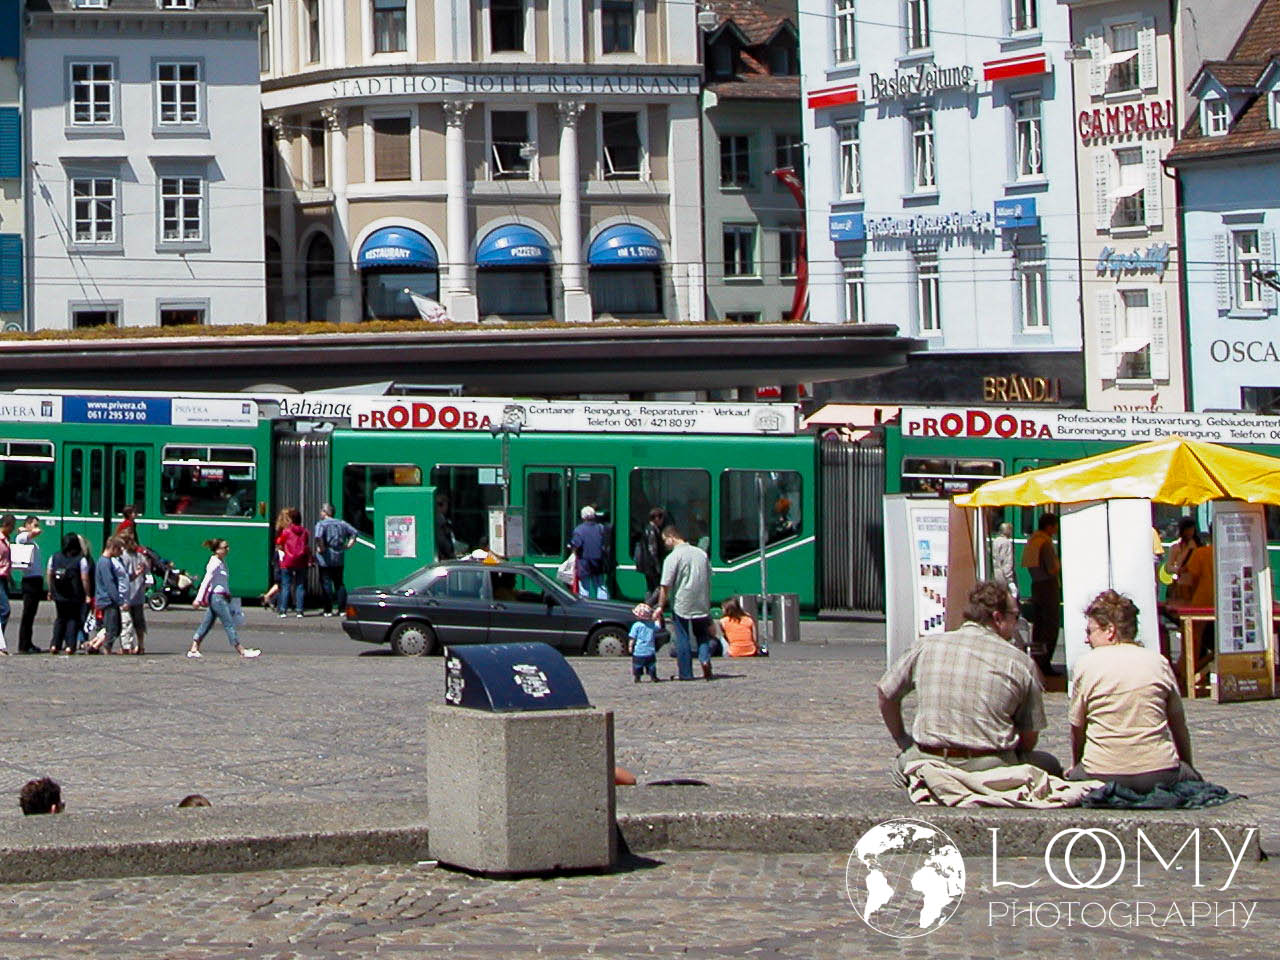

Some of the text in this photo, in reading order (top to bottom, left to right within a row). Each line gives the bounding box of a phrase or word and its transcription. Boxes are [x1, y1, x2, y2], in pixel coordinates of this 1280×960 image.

[331, 75, 697, 97] STADTHOF HOTEL RESTAURANT
[870, 62, 974, 99] Basler Zeitung
[1078, 100, 1174, 139] CAMPARI
[510, 246, 542, 257] PIZZERIA
[983, 373, 1061, 403] BRÄNDLI
[87, 401, 147, 410] www.privera.ch
[529, 405, 575, 414] Container
[640, 406, 698, 417] Reparaturen
[713, 408, 751, 416] Verkauf
[87, 411, 102, 419] 061
[108, 411, 123, 420] 295
[135, 411, 147, 420] 00
[358, 402, 492, 429] PRODOBA
[1057, 414, 1127, 424] Professionelle
[1206, 416, 1280, 427] Gebäudeunter
[587, 418, 620, 427] Telefon
[624, 418, 642, 427] 061
[651, 419, 667, 427] 421
[669, 419, 683, 427] 80
[685, 419, 696, 428] 97
[908, 410, 1053, 438] PRODOBA
[1131, 427, 1150, 436] und
[1230, 429, 1266, 439] Telefon
